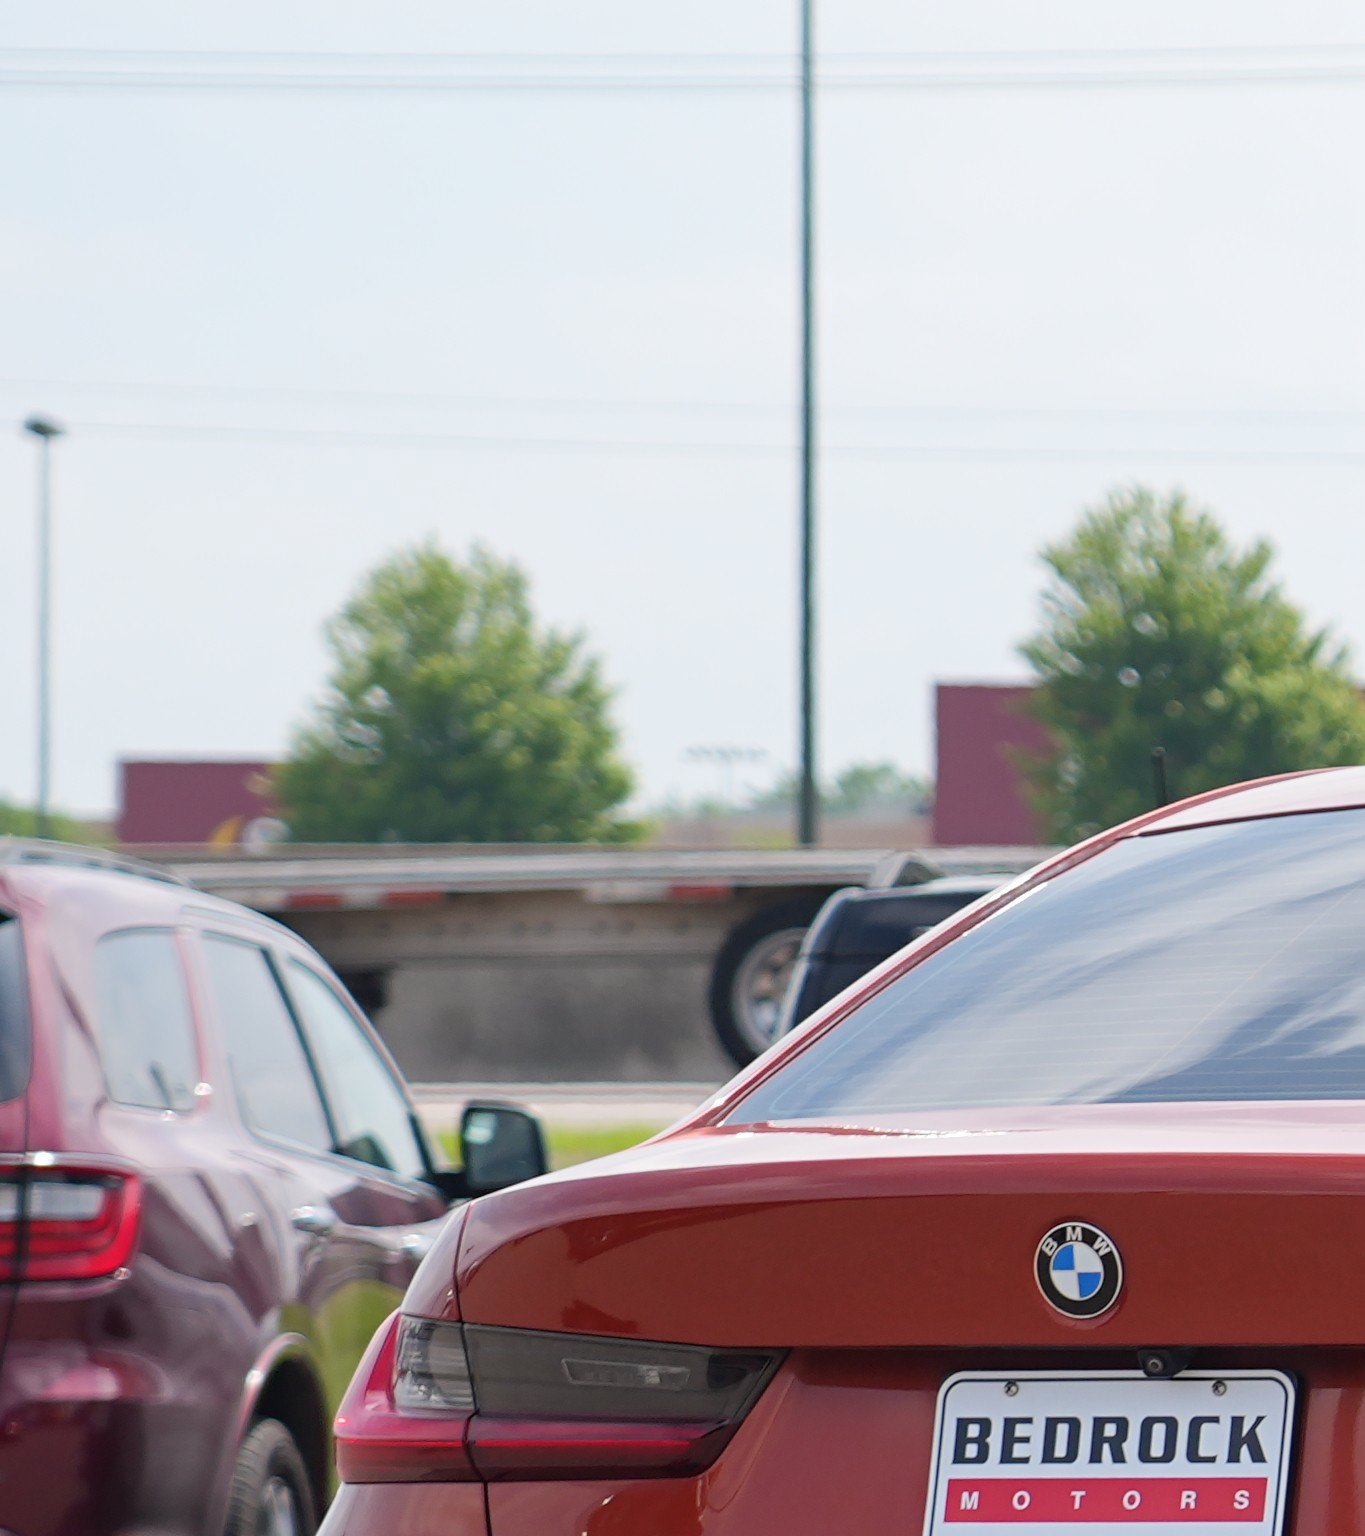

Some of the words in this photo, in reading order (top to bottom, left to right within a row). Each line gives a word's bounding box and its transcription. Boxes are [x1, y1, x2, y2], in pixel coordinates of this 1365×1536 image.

[1041, 1226, 1112, 1257] BMW
[952, 1415, 1268, 1465] BEDROCK
[959, 1490, 1251, 1511] MOTORS
